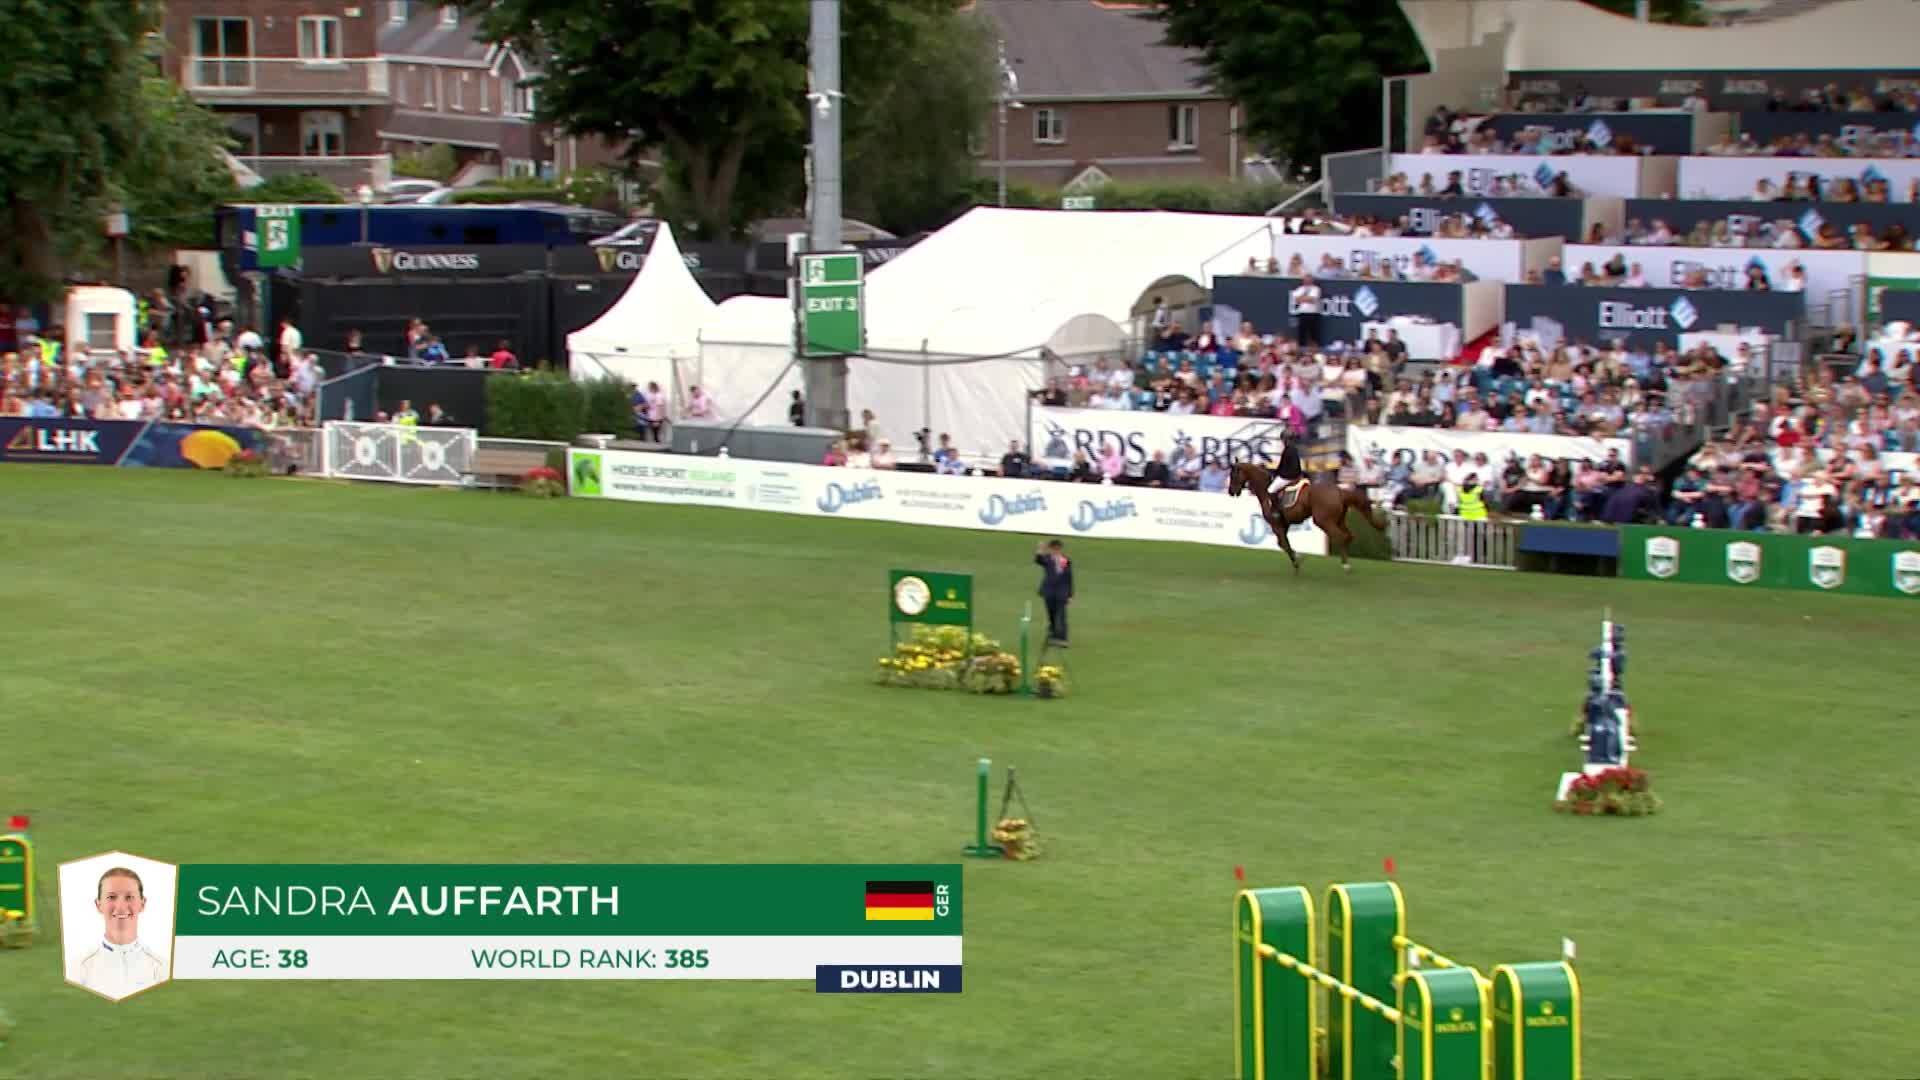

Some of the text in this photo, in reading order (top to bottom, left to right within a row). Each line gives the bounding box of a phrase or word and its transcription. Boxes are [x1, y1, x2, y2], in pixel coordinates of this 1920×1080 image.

[393, 253, 479, 270] GUINNESS
[807, 297, 842, 312] EXIT
[1600, 301, 1668, 329] Elliott
[37, 429, 100, 452] LHK
[1074, 428, 1147, 466] RDS
[816, 482, 883, 513] Dublin
[978, 493, 1047, 525] Dublin
[1069, 499, 1138, 531] Dublin
